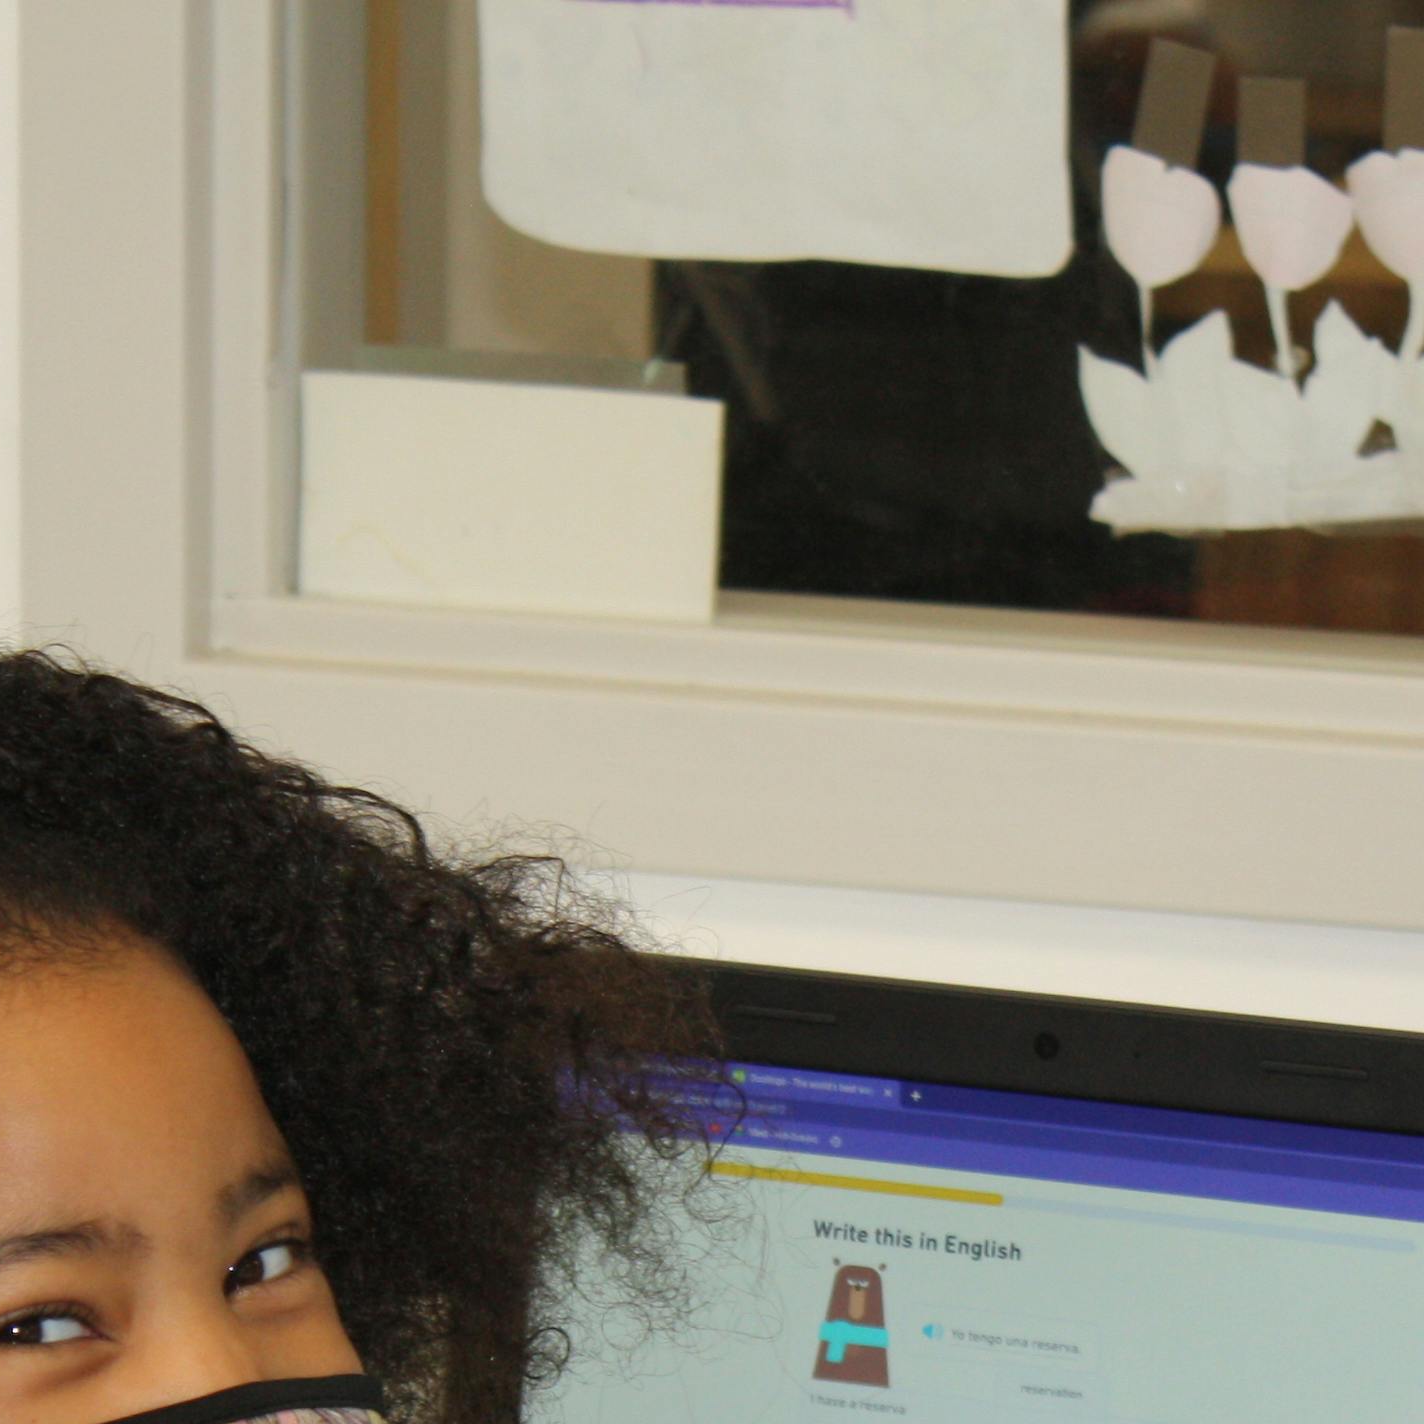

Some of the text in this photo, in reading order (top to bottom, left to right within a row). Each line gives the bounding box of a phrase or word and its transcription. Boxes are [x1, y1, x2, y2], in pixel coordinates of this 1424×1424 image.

[813, 1219, 1023, 1261] Write this in English
[967, 1331, 1003, 1347] tengo
[1004, 1336, 1029, 1349] una
